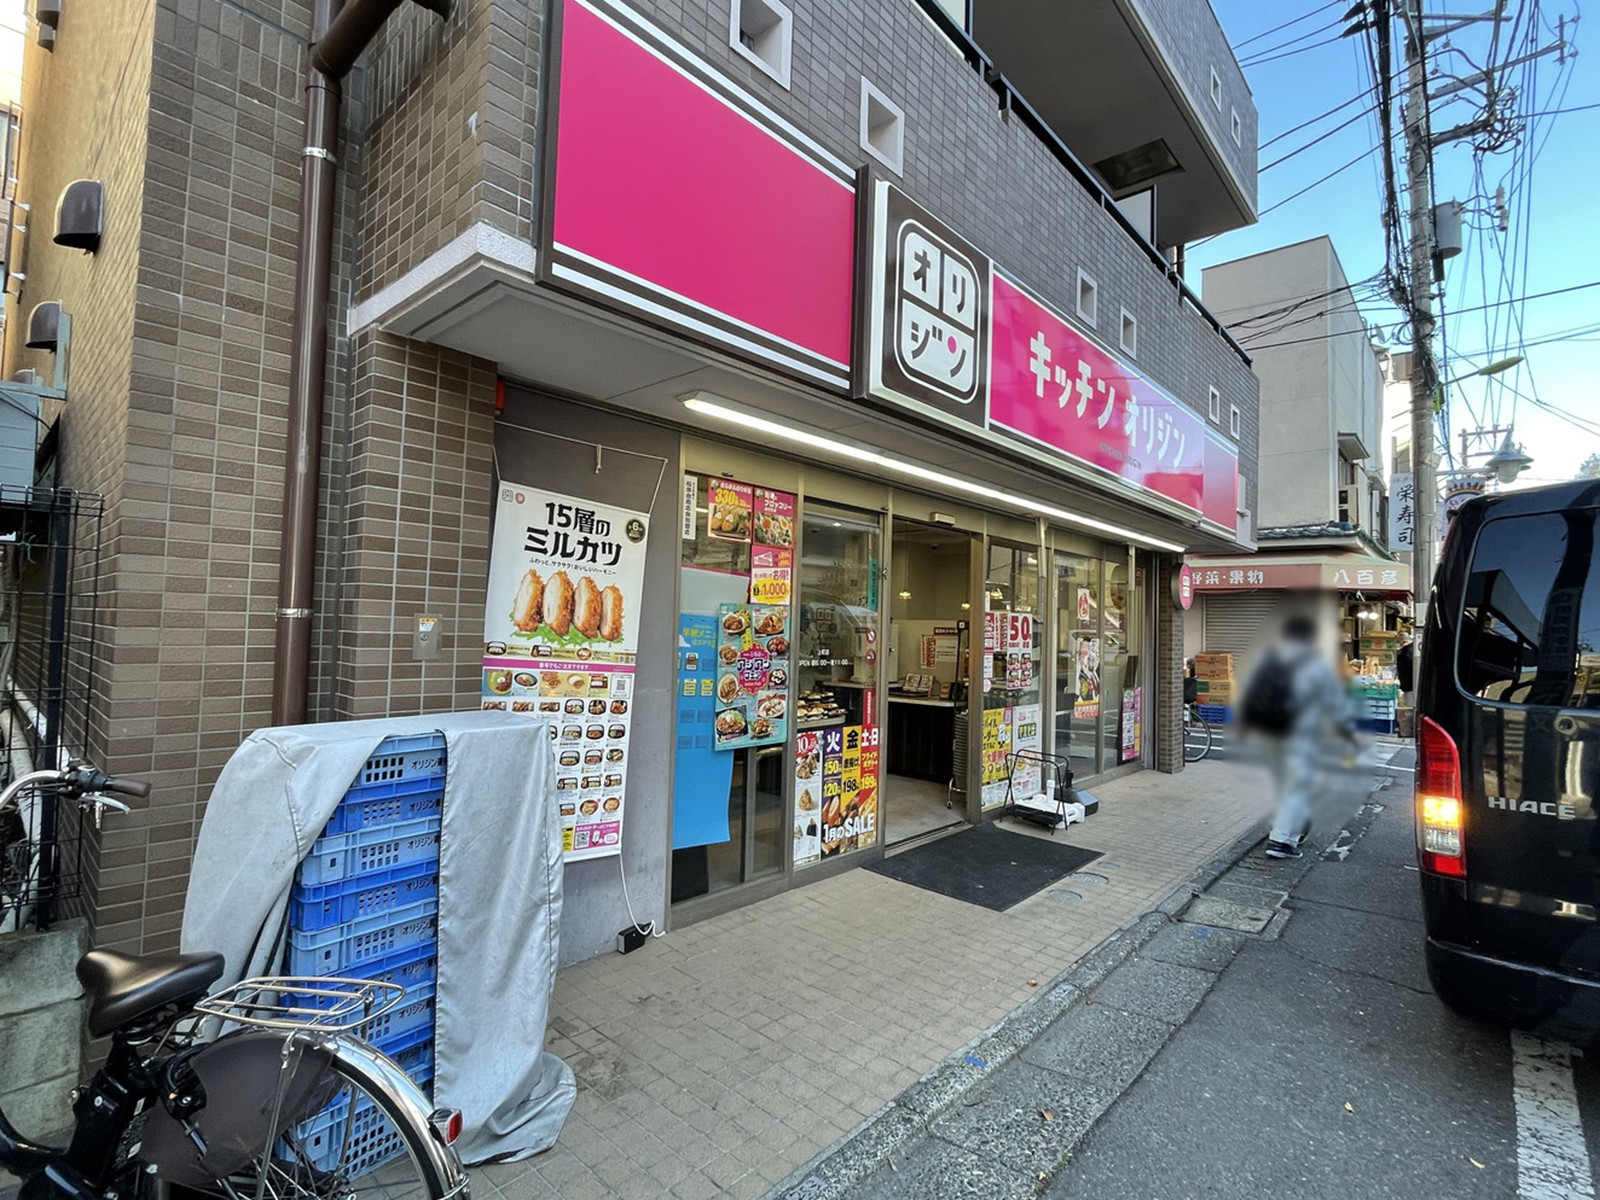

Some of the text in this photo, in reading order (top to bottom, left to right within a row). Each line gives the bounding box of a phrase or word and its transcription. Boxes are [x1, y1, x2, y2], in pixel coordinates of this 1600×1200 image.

[913, 249, 966, 313] オリ
[1030, 330, 1185, 468] キッチン オリジン
[545, 502, 611, 537] 15層の
[1397, 483, 1414, 546] 栄寿司
[524, 526, 623, 566] ミルカツ
[1333, 568, 1399, 585] 八百彦
[736, 658, 771, 671] アジアン
[826, 731, 841, 753] 火
[846, 729, 859, 750] 金
[1488, 796, 1576, 818] HIACE
